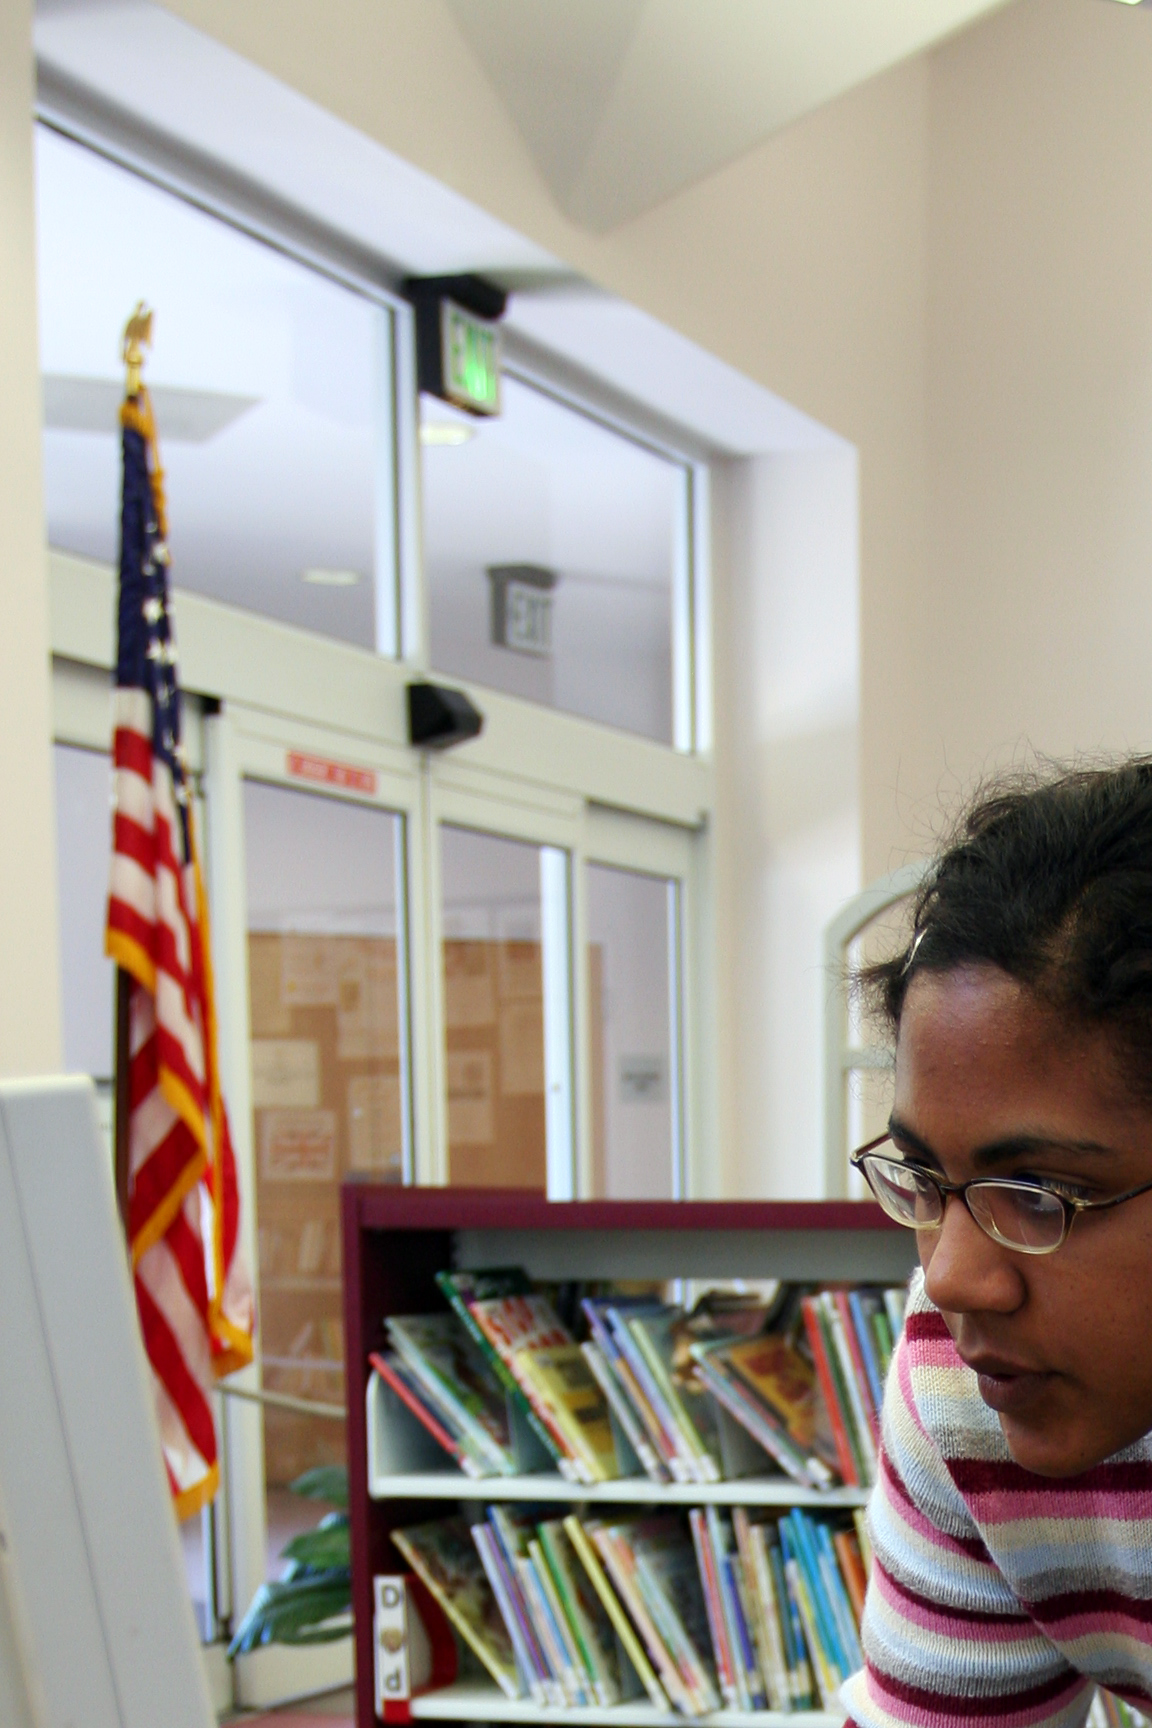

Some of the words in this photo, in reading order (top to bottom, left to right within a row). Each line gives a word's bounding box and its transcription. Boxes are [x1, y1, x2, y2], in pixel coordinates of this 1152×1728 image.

[449, 310, 496, 405] EXIT
[512, 588, 552, 645] EXIT
[381, 1585, 400, 1609] D
[385, 1667, 401, 1691] d
